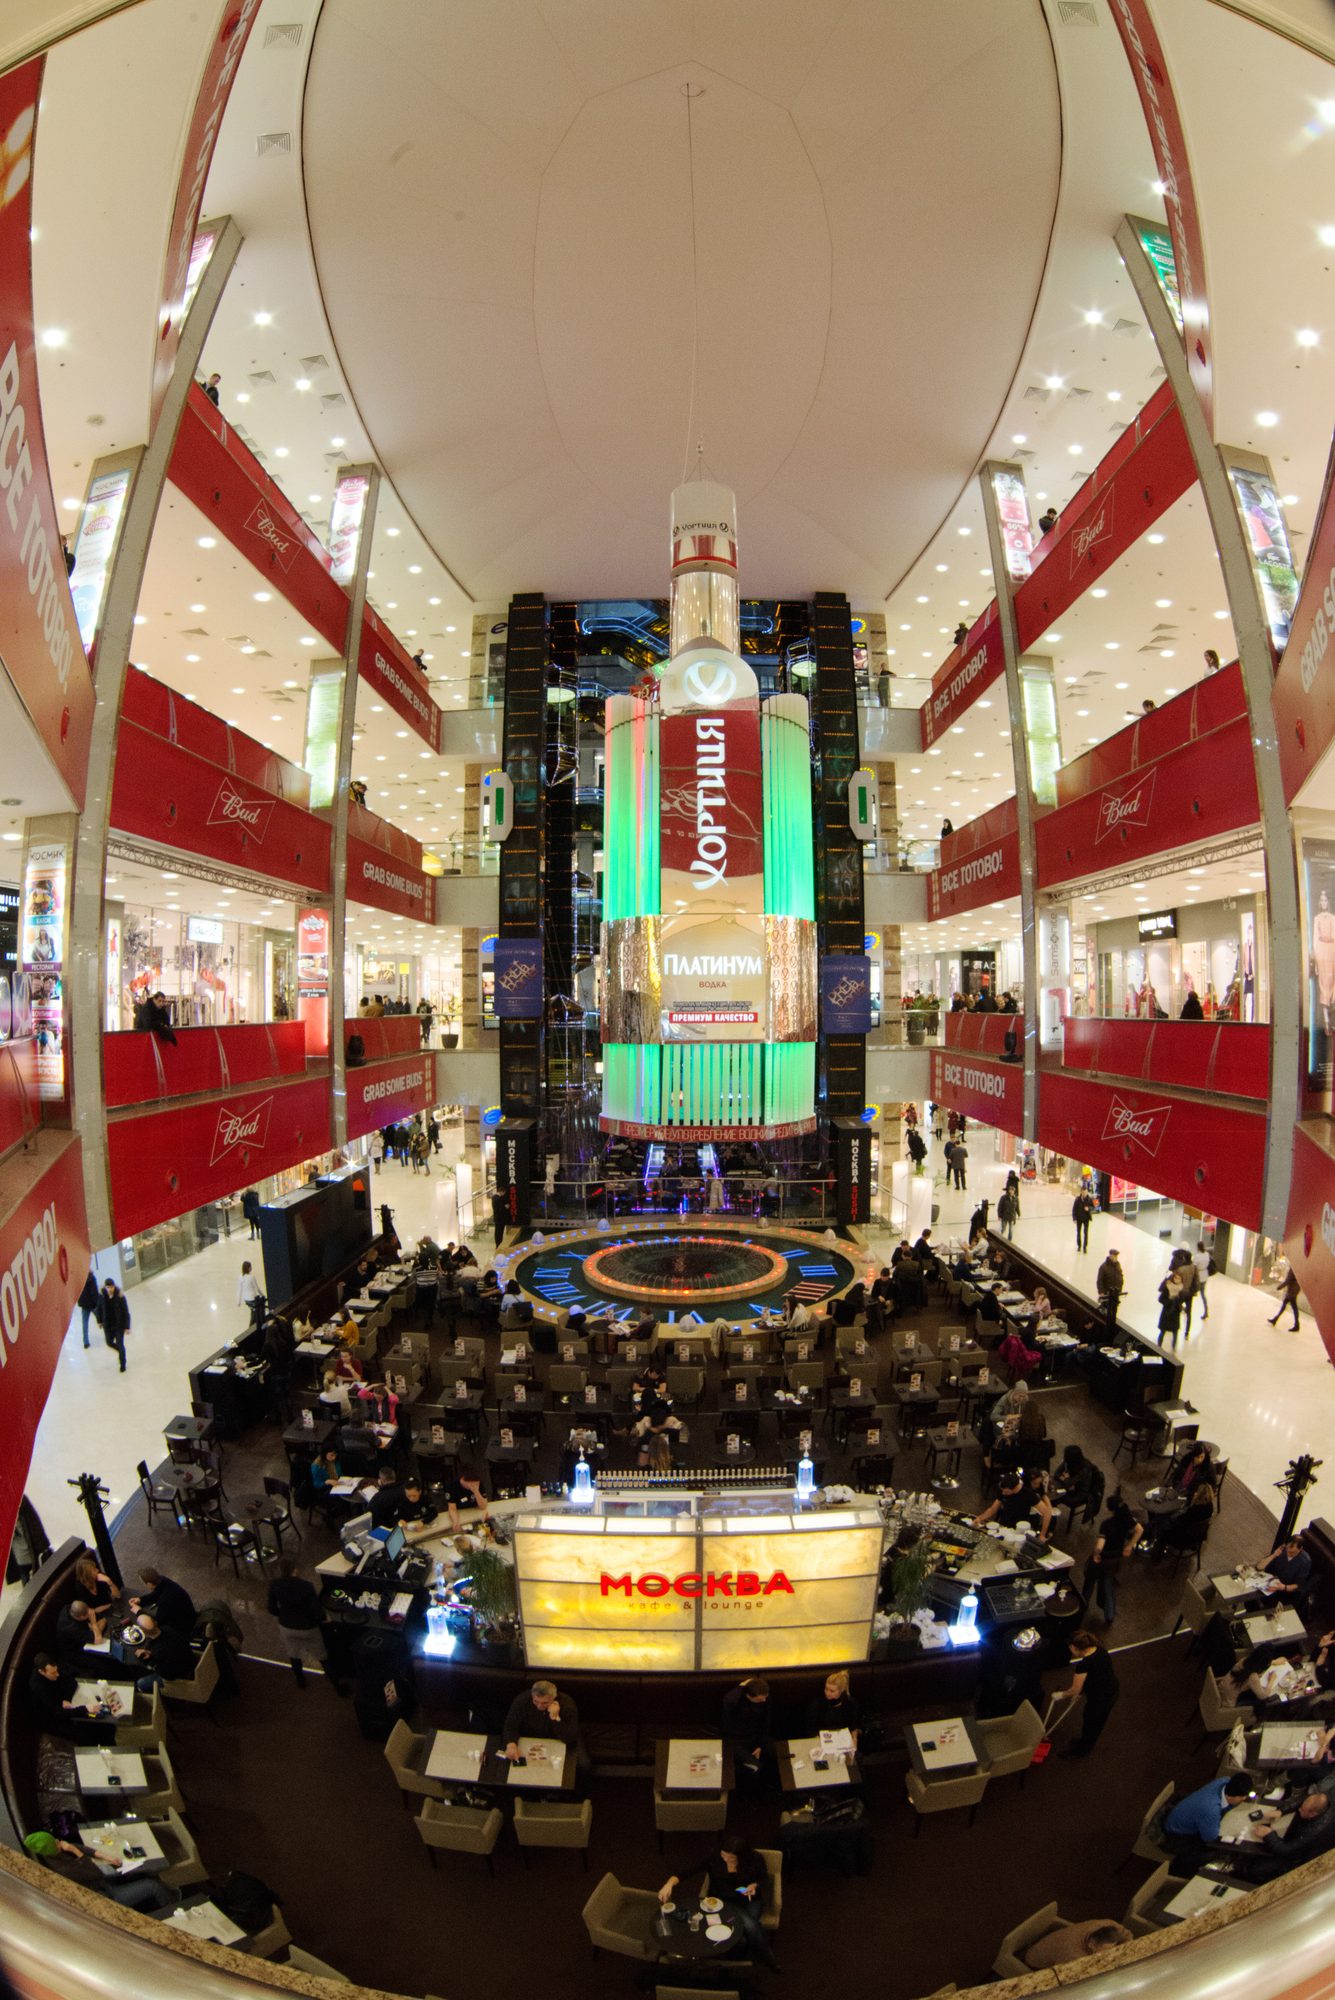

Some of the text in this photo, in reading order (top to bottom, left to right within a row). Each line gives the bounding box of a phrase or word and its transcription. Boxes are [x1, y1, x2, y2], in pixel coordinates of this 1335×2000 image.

[257, 509, 289, 553] Bud
[1073, 509, 1105, 557] Bud
[20, 495, 74, 696] ГОТОВО!
[1301, 607, 1328, 694] GRAB
[375, 652, 396, 684] GRAB
[395, 674, 414, 705] SOME
[934, 644, 988, 719] ВСЕ ГОТОВО!
[220, 791, 261, 825] Bud
[1102, 790, 1142, 826] Bud
[363, 861, 424, 900] GRAB SOME BUDS
[942, 849, 1003, 894] ВСЕ ГОТОВО!
[699, 981, 727, 989] ВОДКА
[672, 1013, 754, 1022] ПРЕМИУМ КАЧЕСТВО
[363, 1071, 424, 1103] GRAB SOME BUDS
[944, 1064, 1006, 1099] ВСЕ ГОТОВО!
[219, 1113, 260, 1146] Bud
[1111, 1107, 1154, 1136] Bud
[508, 1140, 516, 1184] МОСКВА
[851, 1139, 859, 1183] МОСКВА
[600, 1571, 795, 1598] МОСКВА
[628, 1600, 763, 1611] кафе & lounge
